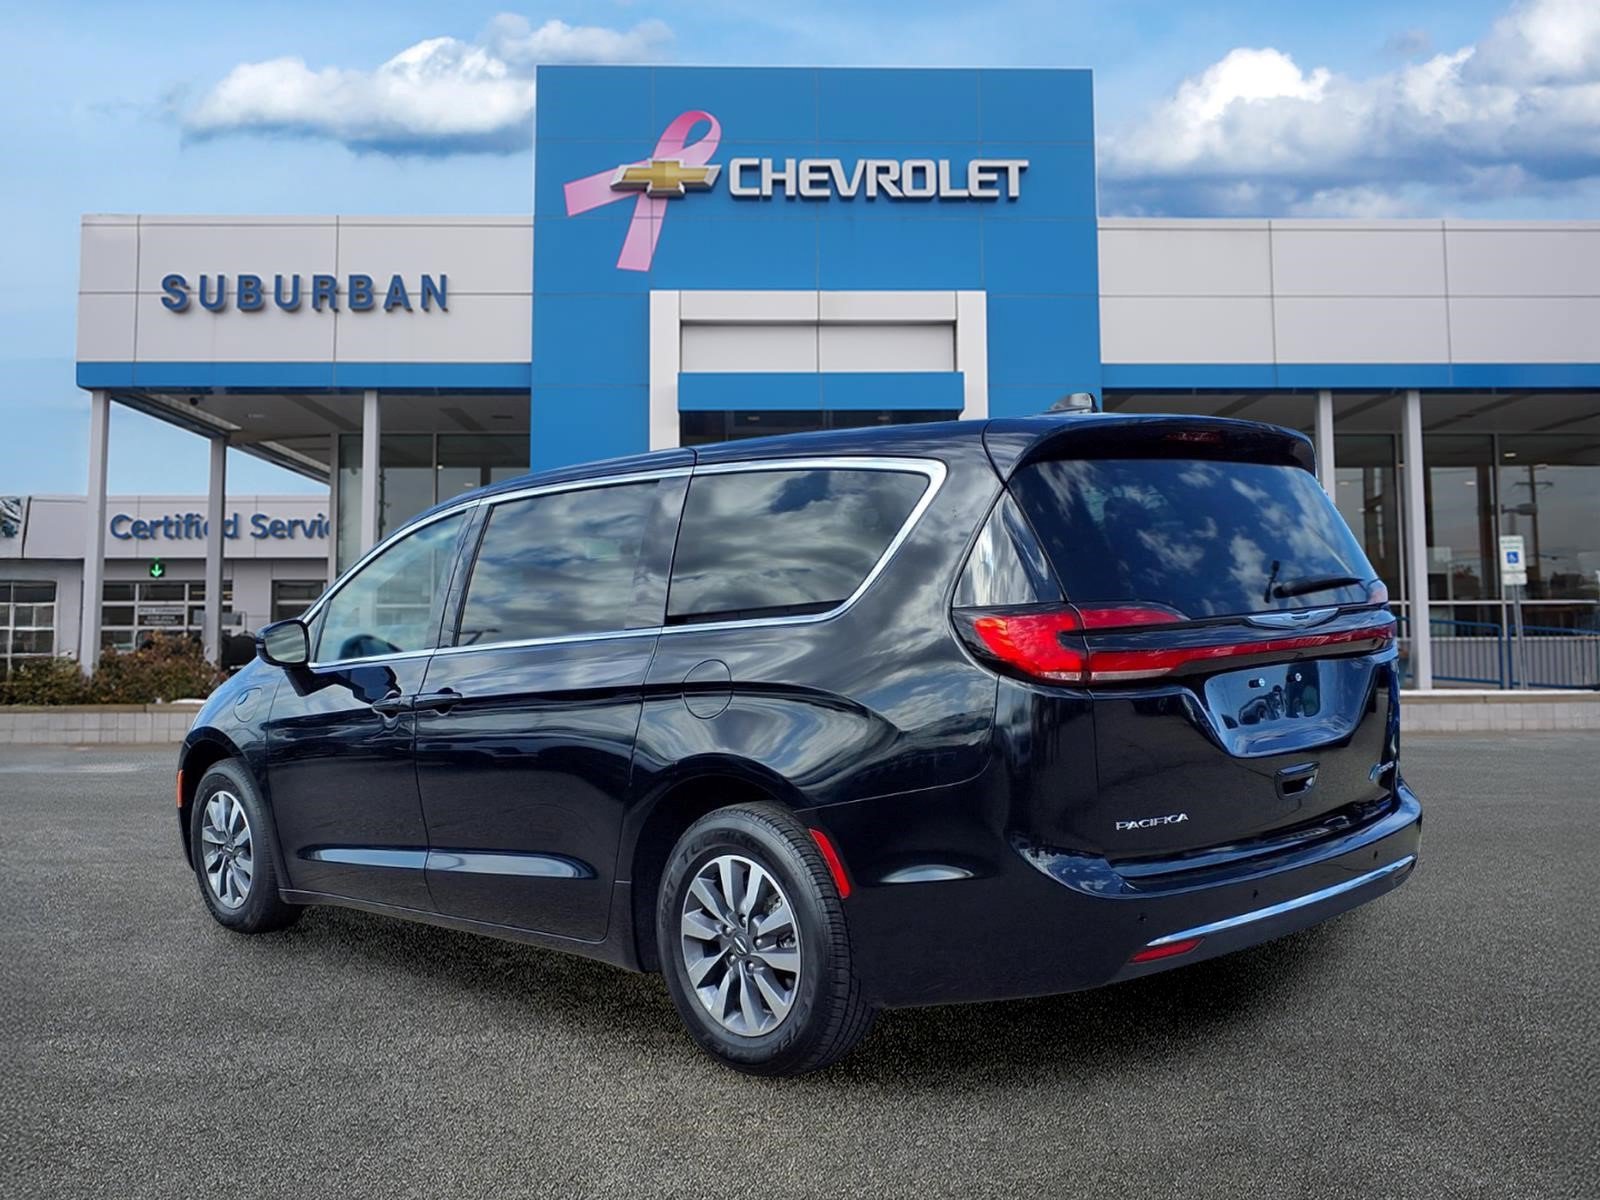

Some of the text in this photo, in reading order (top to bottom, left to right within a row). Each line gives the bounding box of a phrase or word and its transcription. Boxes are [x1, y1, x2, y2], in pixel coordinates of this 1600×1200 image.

[729, 157, 1029, 199] CHEVROLET
[160, 273, 449, 313] SUBURBAN
[1115, 812, 1189, 831] PACIFICA
